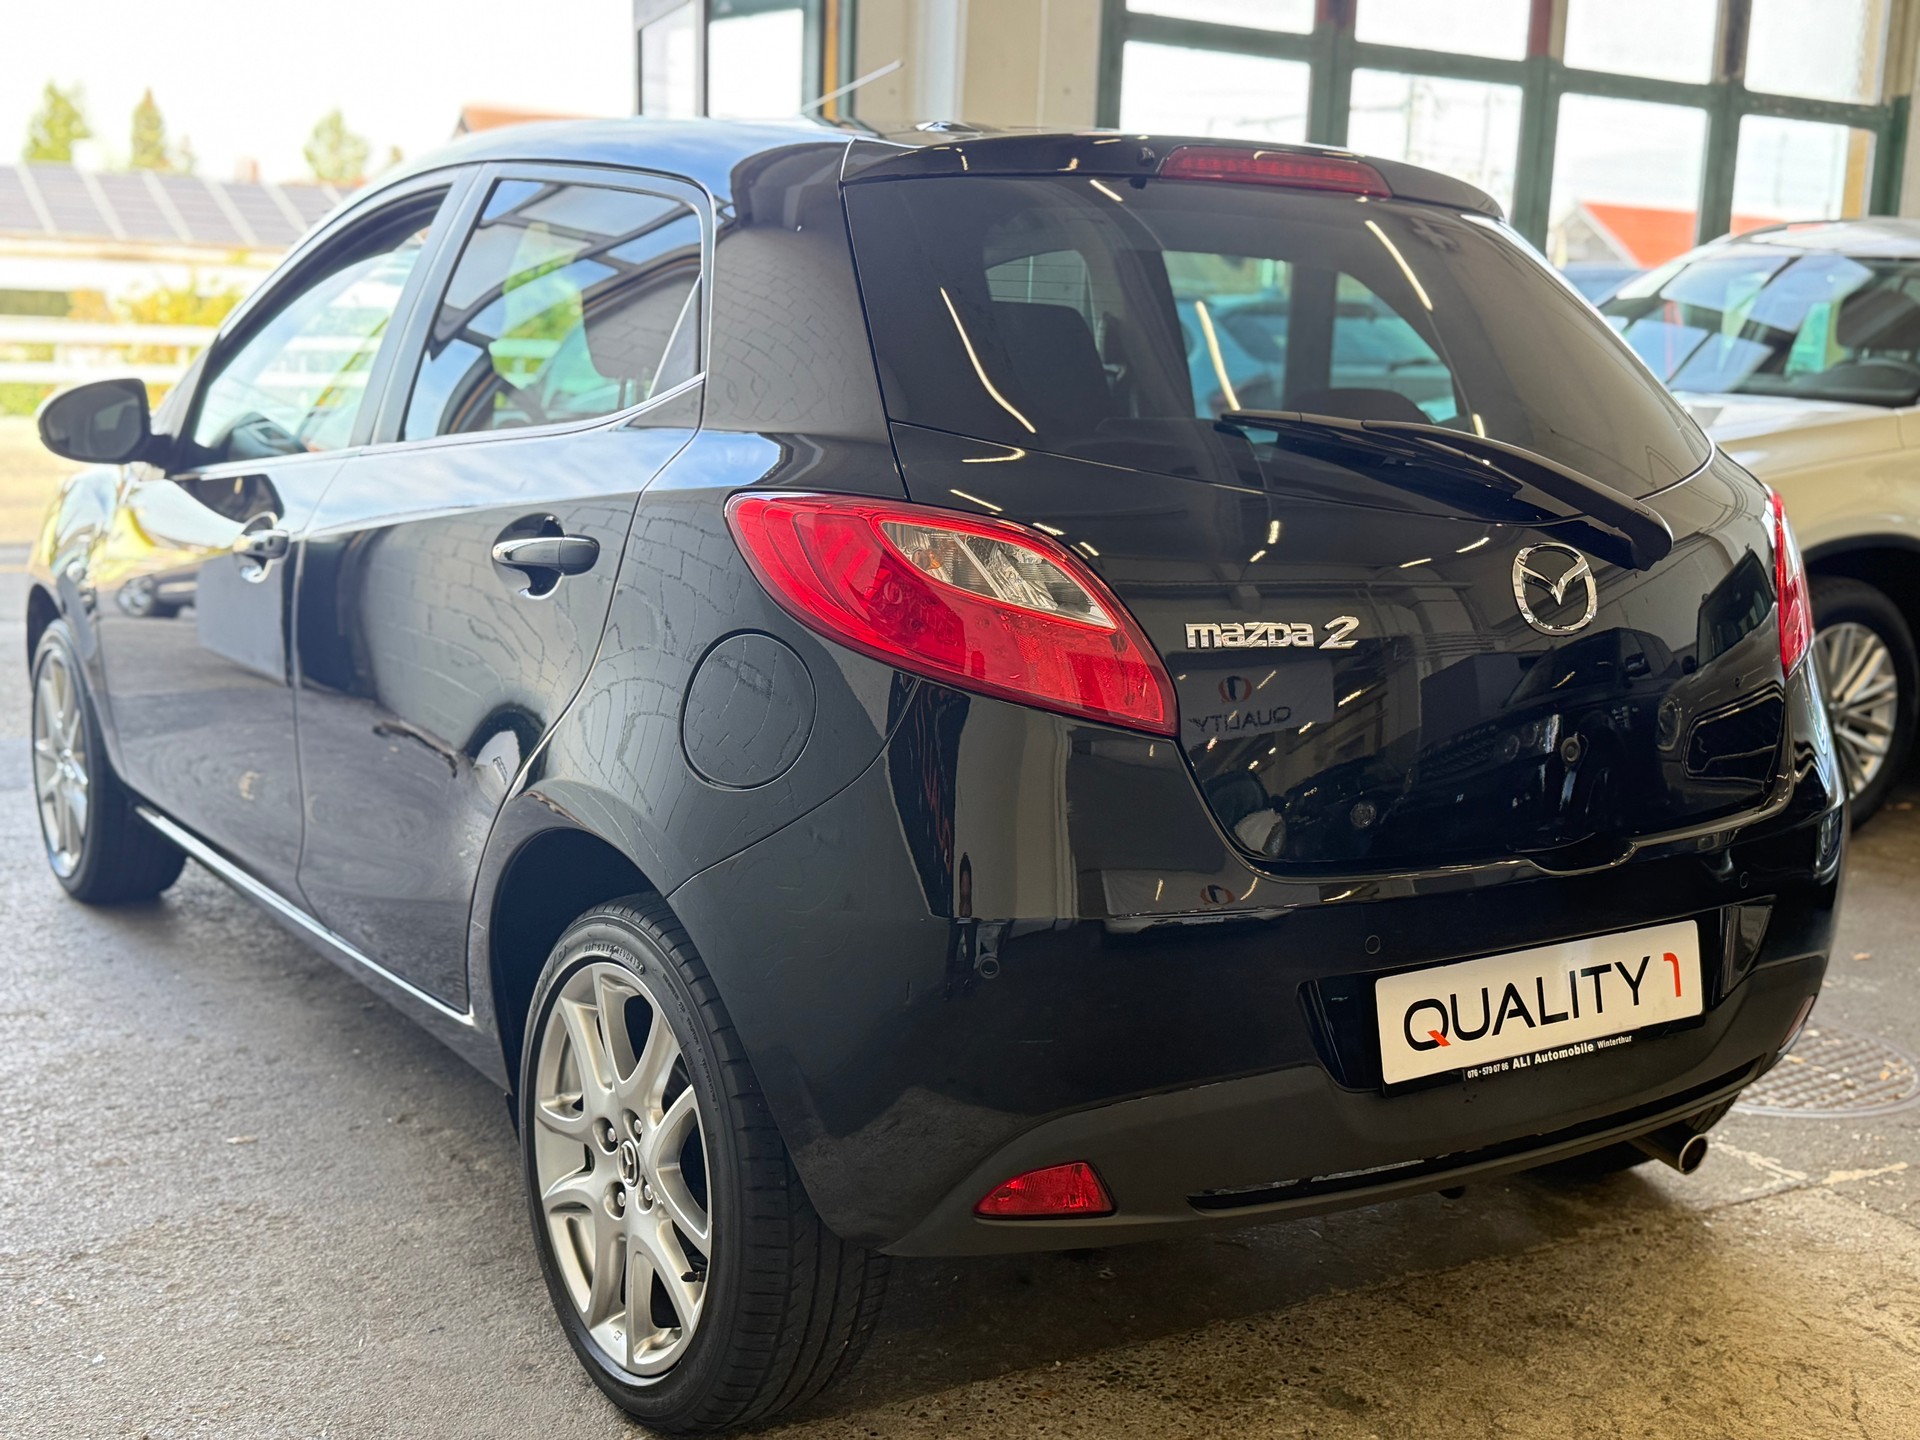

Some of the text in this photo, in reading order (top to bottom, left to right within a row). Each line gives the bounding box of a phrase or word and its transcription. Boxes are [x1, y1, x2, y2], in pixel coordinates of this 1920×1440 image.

[1185, 615, 1360, 650] mazda 2
[1403, 952, 1682, 1052] QUALITY 1
[1512, 1055, 1531, 1070] ALI
[1534, 1042, 1594, 1065] Automobile
[1597, 1035, 1633, 1049] Winterthur
